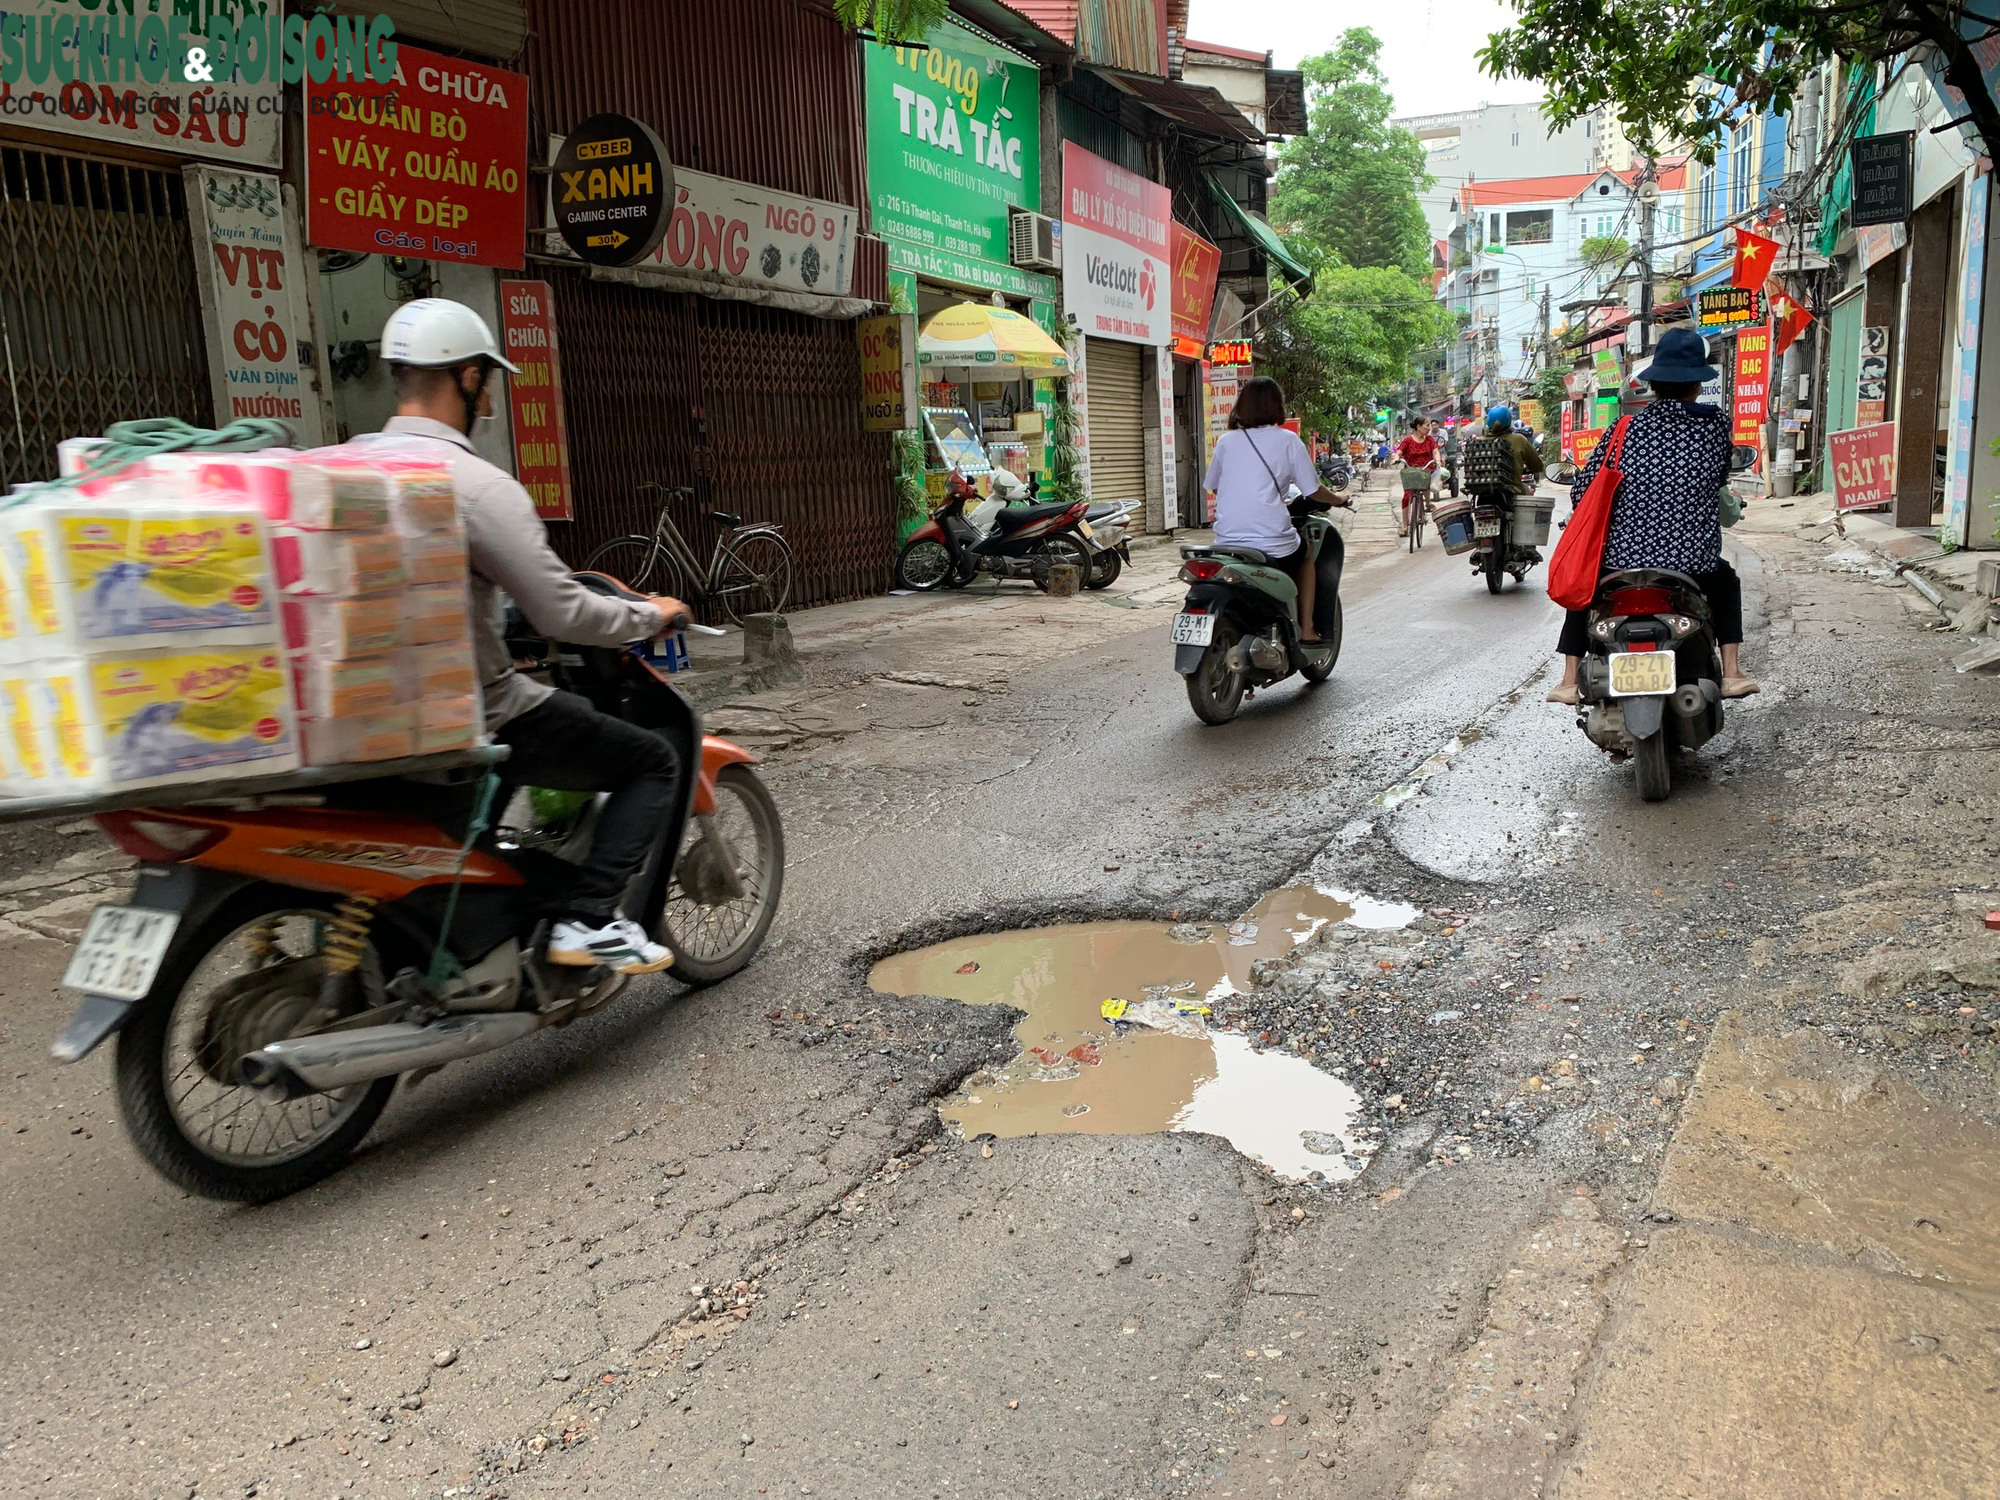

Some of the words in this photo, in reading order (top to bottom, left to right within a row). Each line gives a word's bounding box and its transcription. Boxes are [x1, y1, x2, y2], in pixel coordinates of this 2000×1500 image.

[417, 66, 509, 109] CHỮA
[335, 91, 421, 134] QUẦN
[430, 107, 467, 142] BÒ
[892, 83, 963, 156] TRÀ
[970, 112, 1022, 180] TẮC
[578, 140, 630, 158] CYBER
[1861, 144, 1901, 162] RĂNG
[331, 134, 397, 178] VÁY,
[404, 147, 478, 187] QUẦN
[484, 159, 519, 193] ÁO
[1863, 165, 1899, 182] HÀM
[560, 162, 653, 203] XANH
[1864, 185, 1897, 204] MẶT
[334, 181, 407, 221] GIẦY
[415, 195, 469, 229] DÉP
[567, 209, 606, 224] GAMING
[607, 205, 648, 220] CENTER
[886, 194, 901, 213] 216
[911, 203, 931, 224] Thanh
[374, 229, 426, 250] Các
[433, 235, 477, 259] loại
[597, 235, 620, 245] 30M
[652, 189, 750, 277] ÓNG
[765, 203, 817, 238] NGÕ
[822, 218, 836, 242] 9
[214, 242, 285, 299] VỊT
[901, 246, 922, 269] TRÀ
[923, 249, 943, 273] TẮC
[952, 262, 971, 280] TRÀ
[972, 264, 982, 281] BÍ
[982, 269, 1003, 286] ĐAO
[1010, 273, 1027, 290] TRÀ
[1086, 252, 1137, 295] Vietlott
[510, 288, 540, 316] SỬA
[1703, 292, 1728, 309] VÀNG
[1730, 291, 1749, 310] BẠC
[233, 304, 288, 363] CỎ
[508, 323, 547, 348] CHỮA
[863, 323, 881, 359] ỐC
[1739, 333, 1766, 353] VÀNG
[229, 366, 262, 384] VÂN
[264, 368, 299, 385] ĐÌNH
[863, 364, 902, 396] NÓNG
[1741, 357, 1762, 378] BẠC
[1701, 382, 1721, 396] HUỐC
[1737, 380, 1764, 397] NHẪN
[231, 391, 303, 419] NƯỚNG
[521, 396, 547, 428] VÁY
[866, 400, 892, 418] NGÕ
[1738, 399, 1761, 414] CƯỚI
[1740, 419, 1758, 428] MUA
[1849, 429, 1879, 442] Kevin
[520, 434, 544, 469] QUẦN
[544, 476, 562, 507] DÉP
[1844, 488, 1881, 505] NAM
